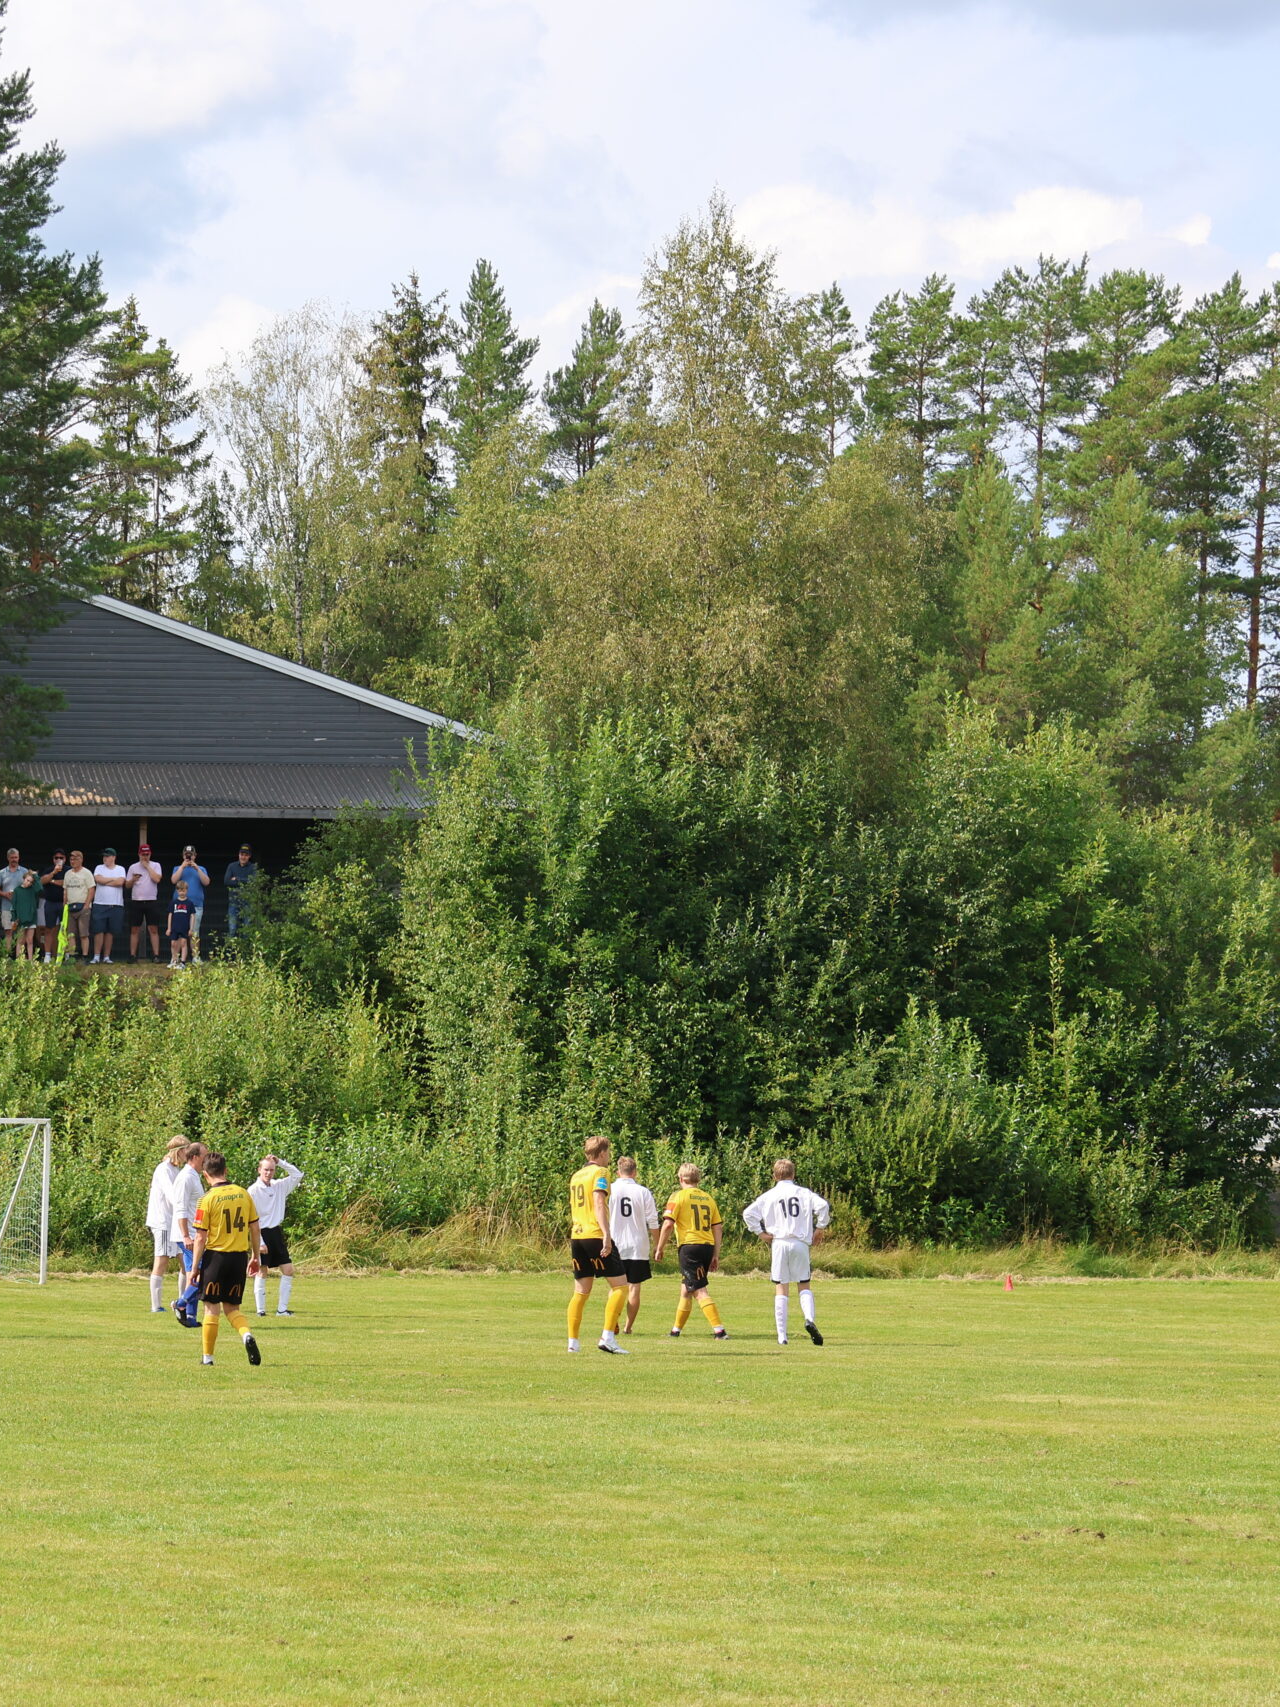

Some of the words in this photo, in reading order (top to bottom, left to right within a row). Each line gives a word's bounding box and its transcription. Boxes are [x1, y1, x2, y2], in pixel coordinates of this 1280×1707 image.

[217, 1193, 244, 1203] Europris
[571, 1183, 585, 1207] 19
[620, 1196, 632, 1217] 6
[691, 1204, 711, 1231] 13
[779, 1196, 800, 1219] 16
[223, 1206, 245, 1234] 14
